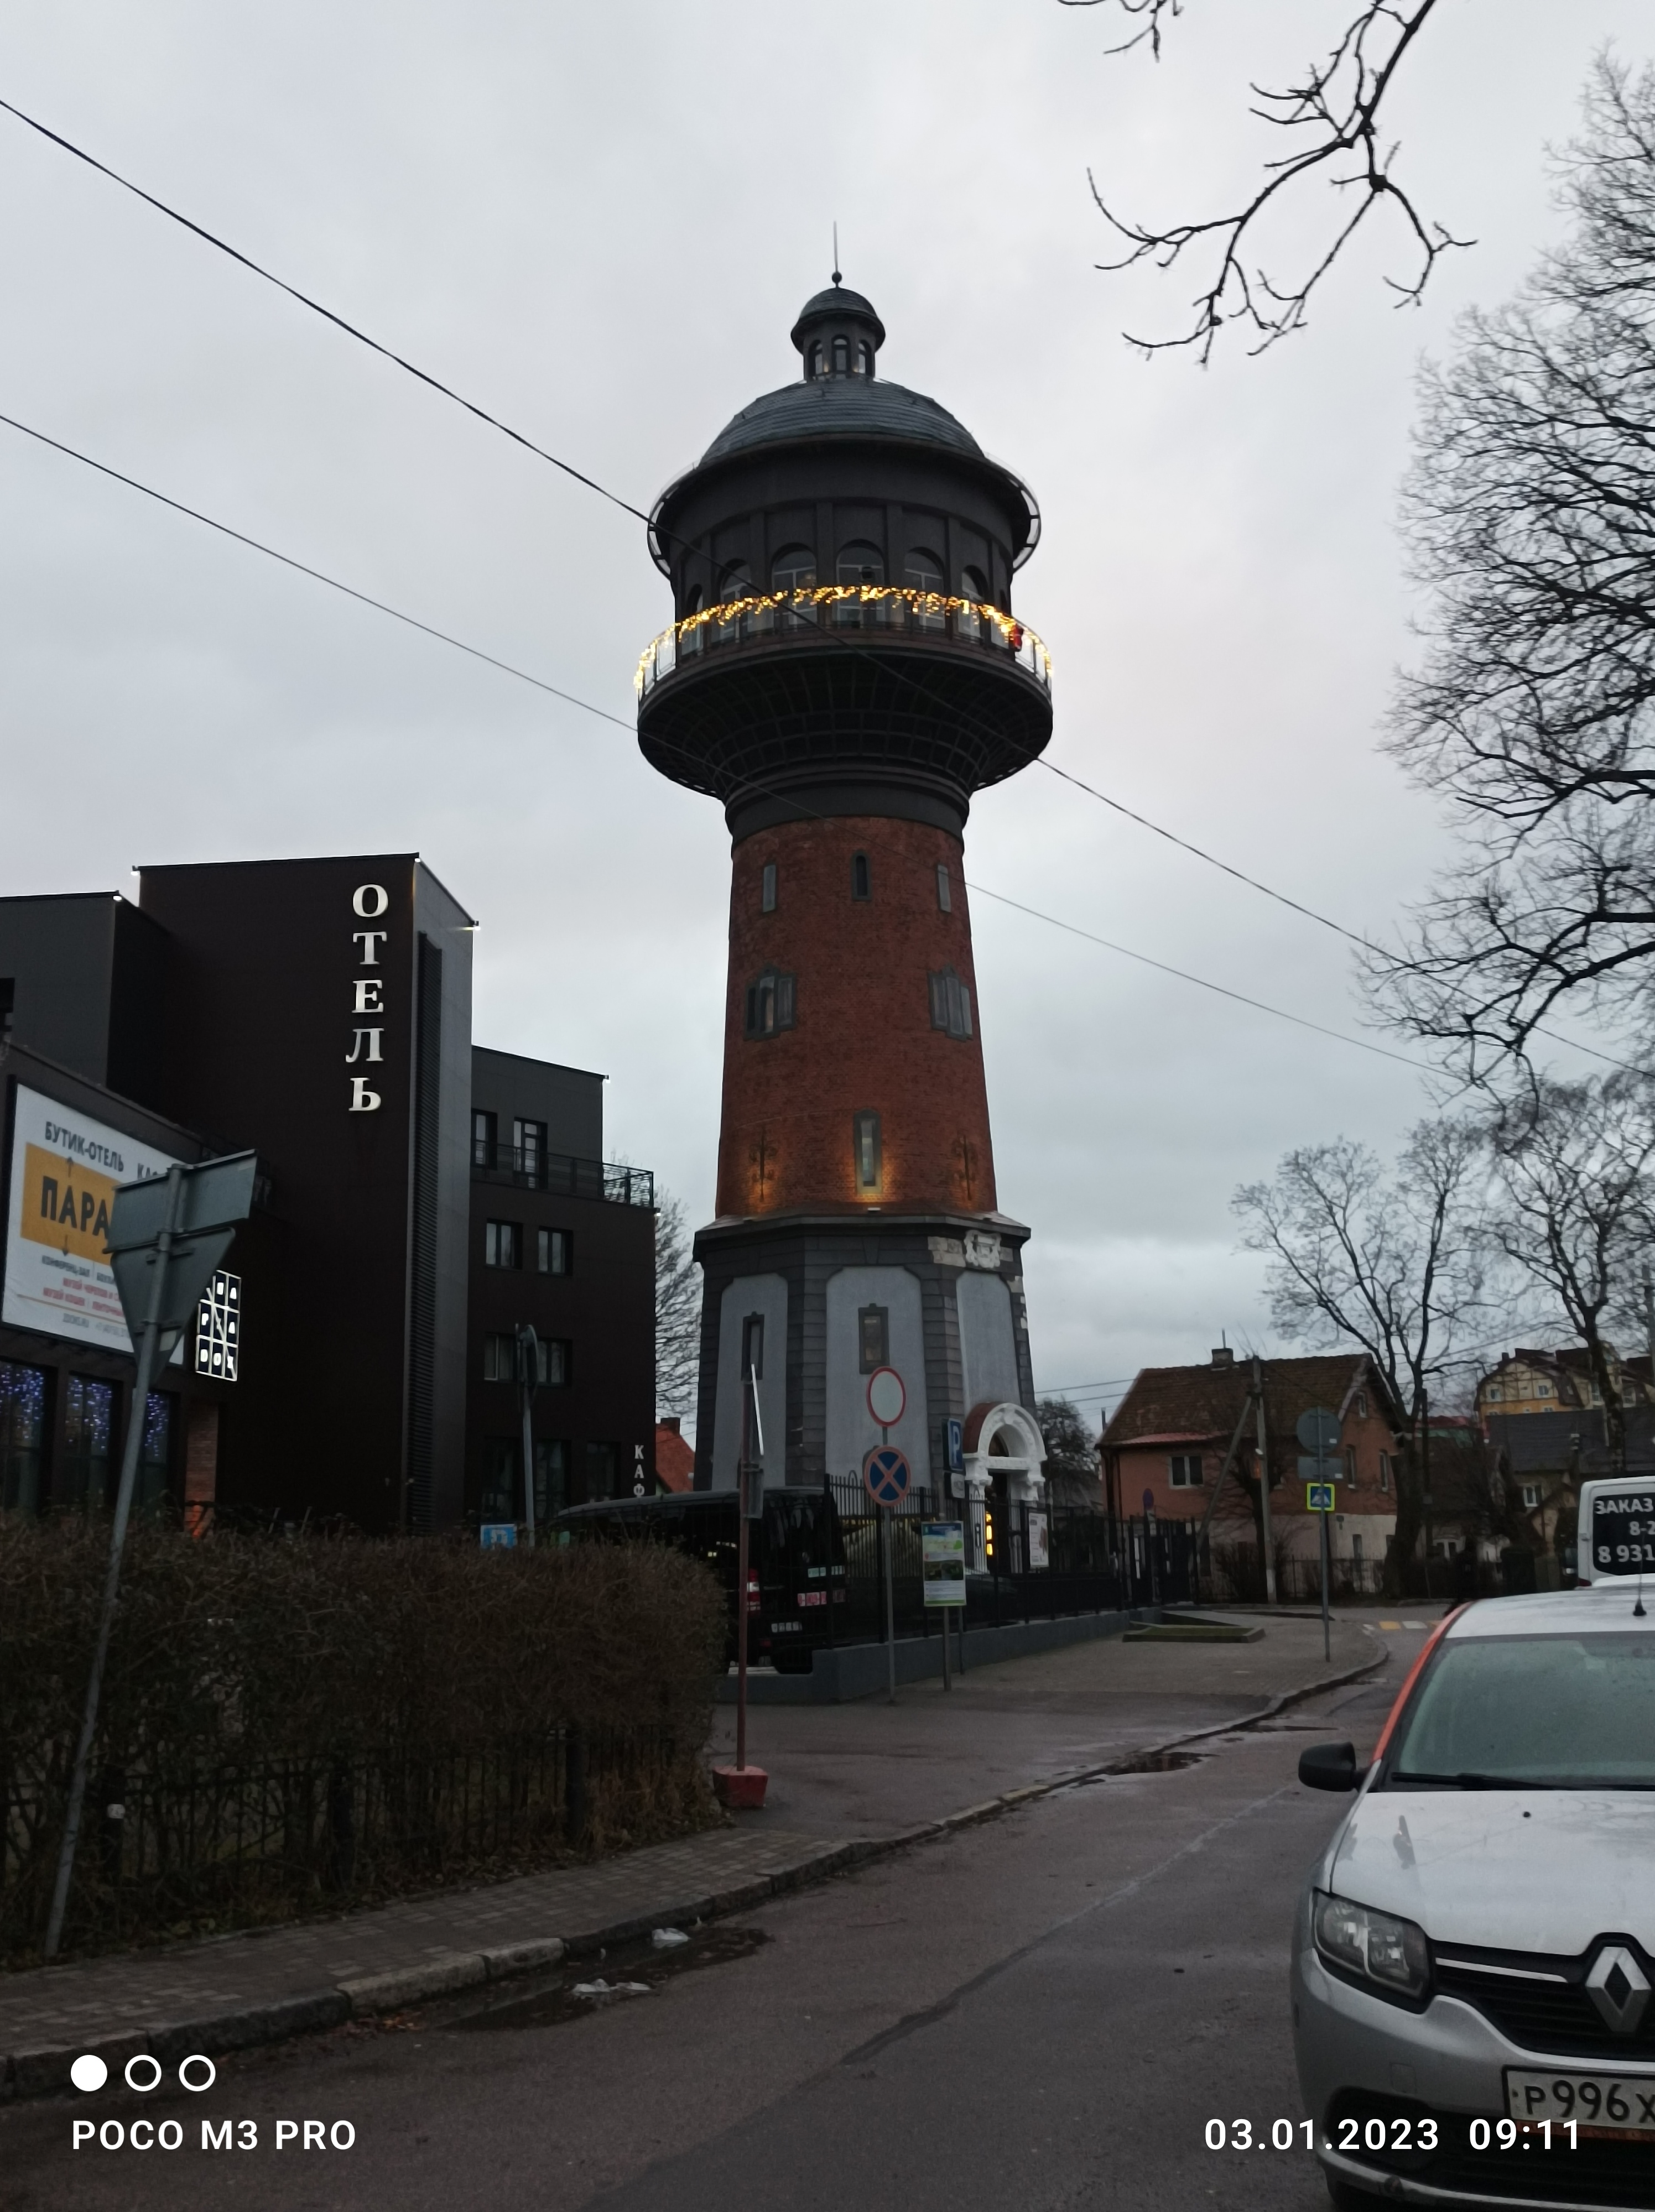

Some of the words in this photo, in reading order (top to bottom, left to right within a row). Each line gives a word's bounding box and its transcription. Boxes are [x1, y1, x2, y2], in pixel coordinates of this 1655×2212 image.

[346, 884, 388, 1111] ОТЕЛЬ
[45, 1121, 123, 1172] БУТИК-ОТЕЛЬ
[1595, 1498, 1654, 1514] ЗАКАЗ
[1598, 1546, 1611, 1563] 8
[1616, 1544, 1655, 1562] 931
